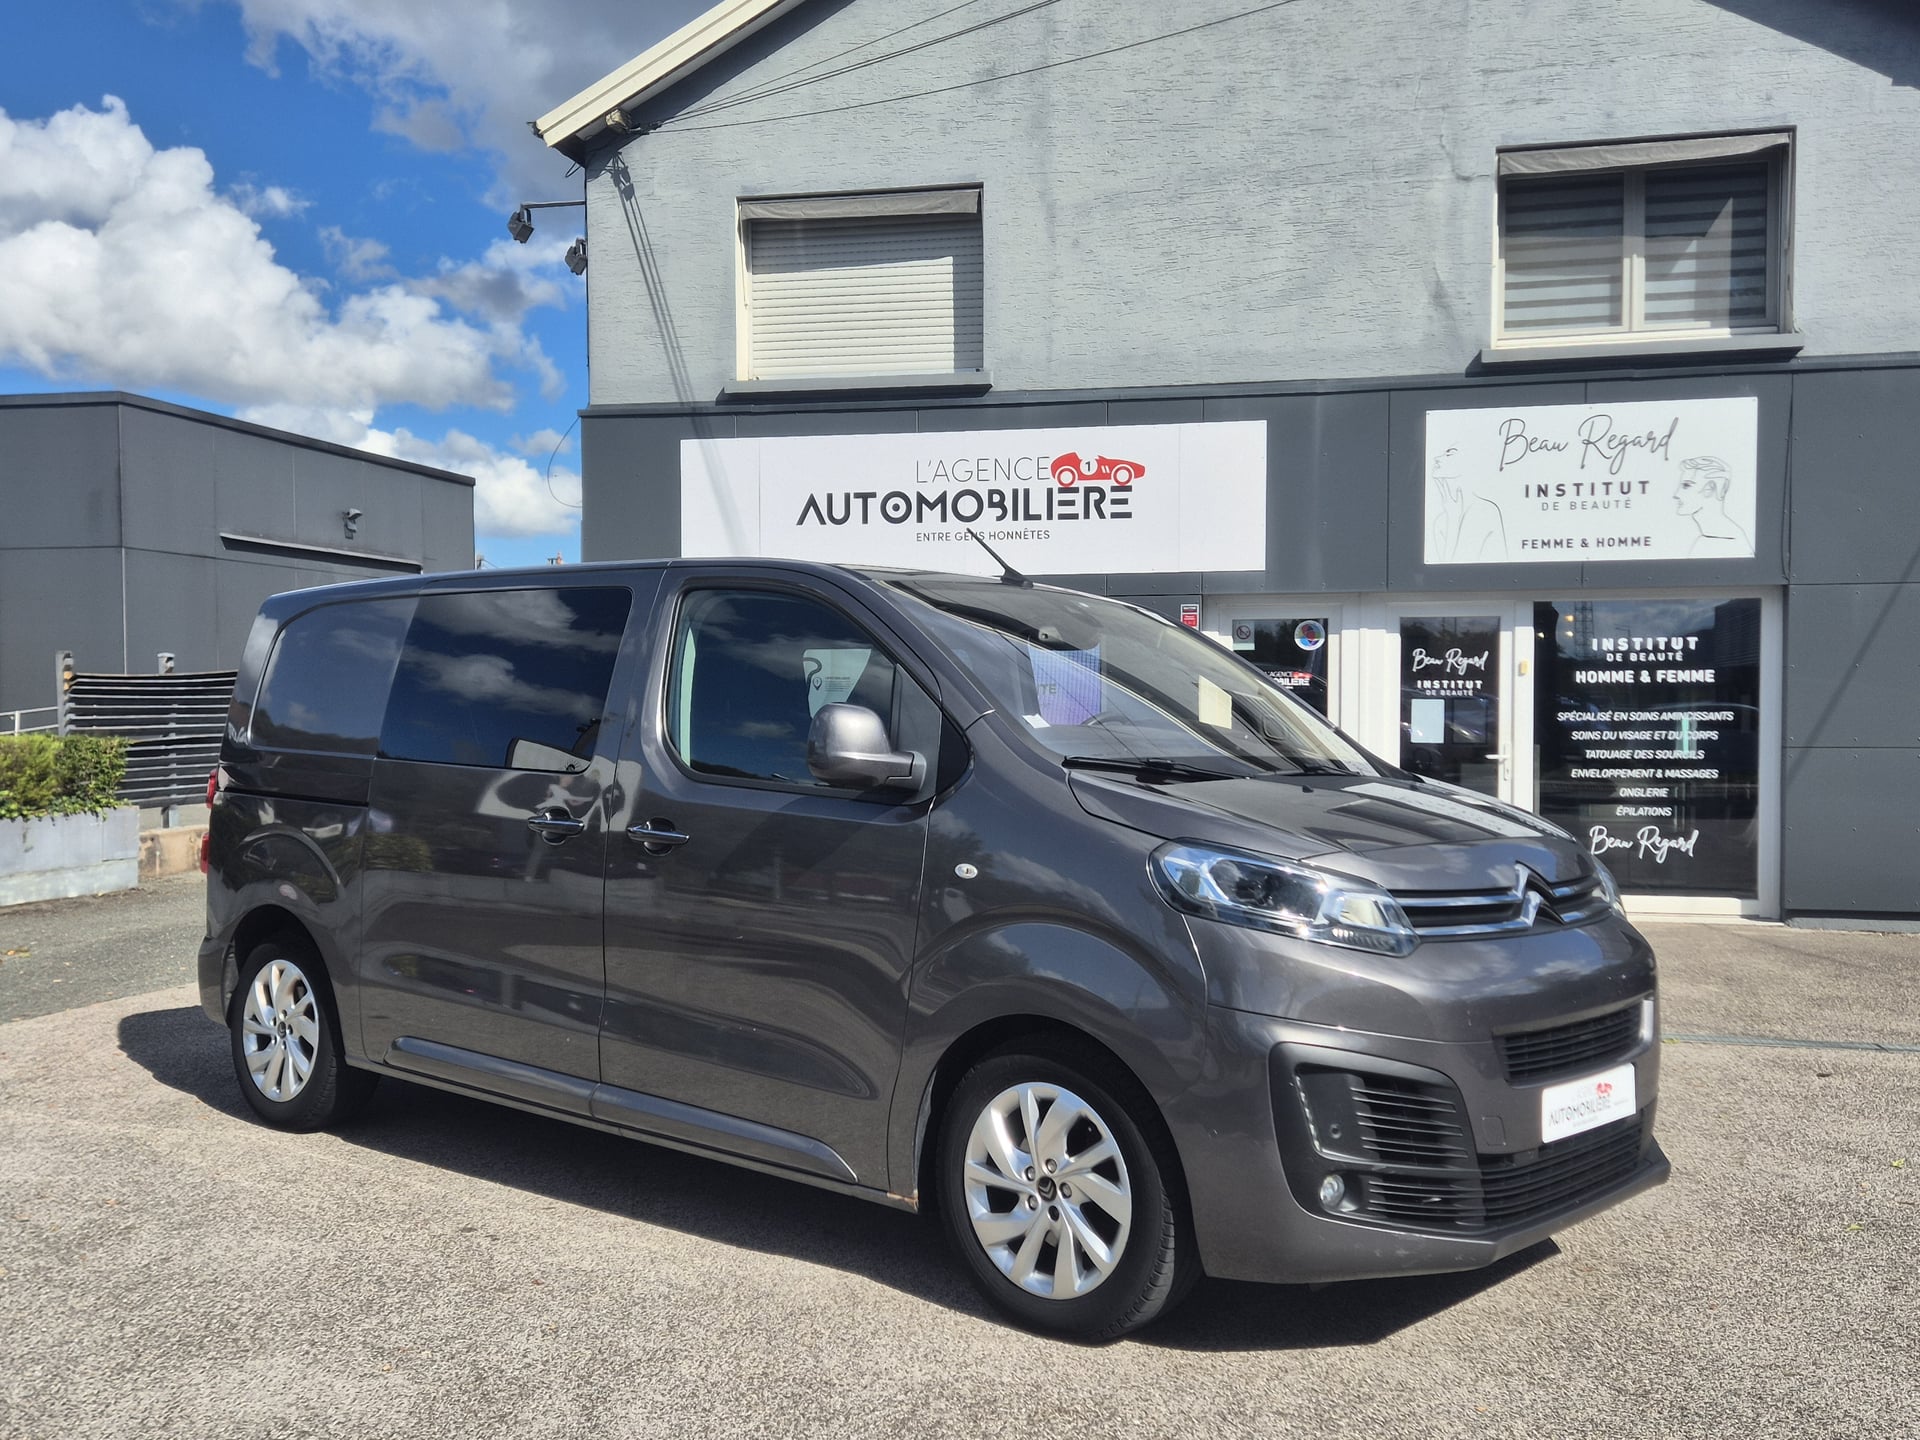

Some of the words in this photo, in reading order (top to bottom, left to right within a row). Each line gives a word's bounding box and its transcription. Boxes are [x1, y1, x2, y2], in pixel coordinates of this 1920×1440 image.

[1499, 418, 1568, 472] Beau
[1577, 414, 1678, 475] Regard
[915, 455, 1051, 484] L'AGENCE
[1085, 461, 1091, 473] 1
[1525, 480, 1650, 498] INSTITUT
[1541, 501, 1560, 511] DE
[1570, 498, 1632, 511] BEAUTÉ
[916, 532, 951, 542] ENTRE
[988, 528, 1051, 541] HONNÊTES
[1521, 537, 1574, 549] FEMME
[1580, 538, 1590, 548] &
[1596, 536, 1652, 548] HOMME
[1591, 636, 1699, 651] INSTITUT
[1412, 648, 1444, 672] Beau
[1445, 648, 1489, 675] Regard
[1606, 652, 1623, 662] DE
[1629, 651, 1684, 662] BEAUTÉ
[1575, 669, 1635, 684] HOMME
[1639, 669, 1652, 683] &
[1656, 669, 1716, 683] FEMME
[1416, 680, 1483, 690] INSTITUT
[1556, 710, 1613, 721] SPÉCIALISÉ
[1613, 712, 1629, 721] EN
[1629, 711, 1660, 721] SOINS
[1660, 711, 1735, 721] AMINCISSANTS
[1571, 731, 1601, 740] SOINS
[1602, 731, 1618, 740] DU
[1618, 731, 1653, 740] VISAGE
[1653, 731, 1667, 740] ET
[1667, 731, 1683, 740] DU
[1686, 731, 1719, 740] CORPS
[1585, 750, 1634, 759] TATOUAGE
[1633, 750, 1654, 759] DES
[1570, 769, 1654, 778] ENVELOPPEMENT
[1654, 769, 1663, 778] &
[1664, 769, 1720, 778] MASSAGES
[1619, 788, 1670, 798] ONGLERIE
[1615, 805, 1673, 816] ÉPILATIONS
[1589, 825, 1633, 856] Beau
[1637, 826, 1699, 864] Regard
